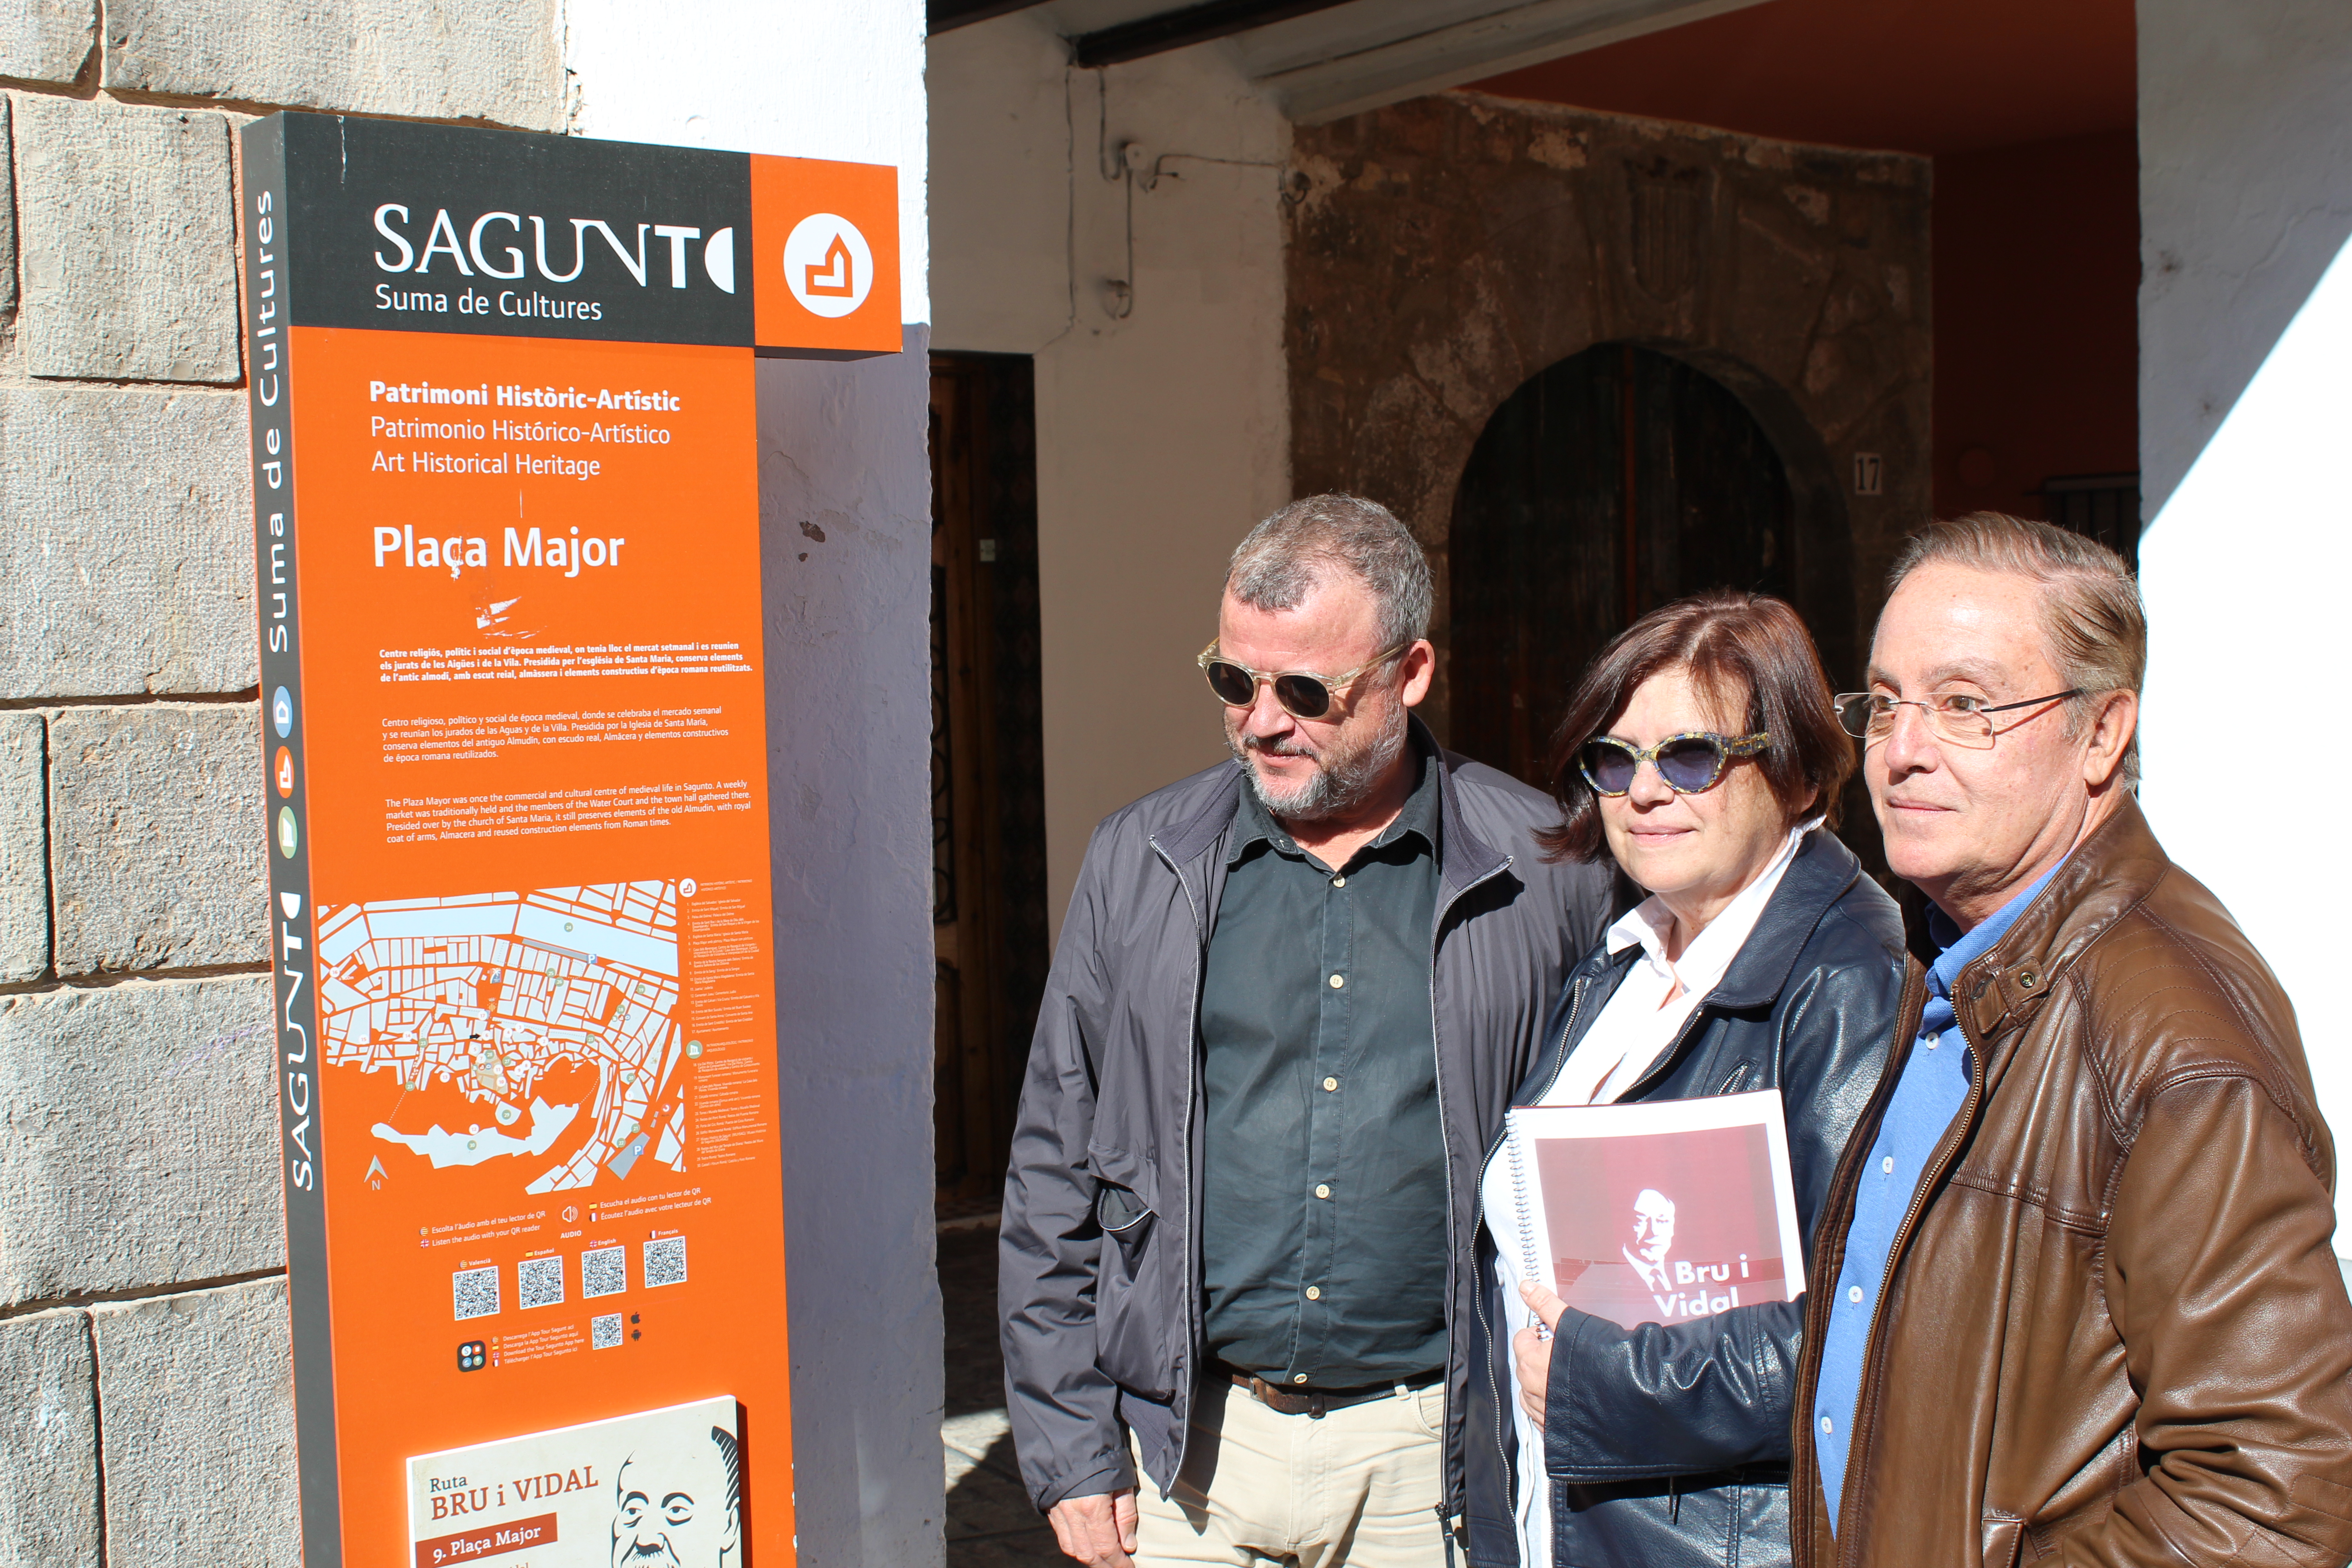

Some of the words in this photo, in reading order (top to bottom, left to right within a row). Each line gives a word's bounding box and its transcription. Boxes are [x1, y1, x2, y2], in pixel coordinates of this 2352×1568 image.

[257, 191, 279, 406] Cultures
[376, 285, 448, 313] Suma
[459, 289, 490, 315] de
[499, 291, 602, 320] Cultures
[370, 381, 488, 406] Patrimoni
[496, 384, 681, 412] Històric-Artístic
[372, 416, 485, 440] Patrimonio
[493, 419, 671, 444] Histórico-Artístico
[263, 428, 282, 490] de
[372, 451, 406, 472] Art
[413, 451, 508, 474] Historical
[516, 453, 601, 481] Heritage
[1857, 458, 1880, 490] 17
[504, 526, 625, 578] Major
[270, 513, 288, 652] Suma
[379, 649, 408, 658] Centre
[409, 648, 443, 659] religiós,
[445, 647, 472, 658] polític
[473, 647, 476, 656] i
[478, 646, 502, 656] social
[503, 646, 534, 657] d'època
[536, 645, 573, 655] medieval,
[587, 644, 608, 653] tenia
[608, 644, 623, 652] lloc
[624, 643, 632, 652] el
[633, 644, 660, 652] mercat
[661, 642, 695, 651] setmanal
[696, 642, 700, 650] i
[710, 641, 739, 650] reunien
[380, 661, 393, 670] els
[393, 661, 420, 672] jurats
[421, 660, 432, 669] de
[433, 660, 446, 669] les
[447, 659, 475, 670] Aigües
[477, 659, 480, 667] i
[482, 658, 493, 667] de
[494, 658, 502, 667] la
[503, 658, 522, 666] Vila.
[524, 657, 561, 666] Presidida
[562, 658, 576, 667] per
[577, 655, 613, 666] l'església
[614, 655, 625, 664] de
[626, 655, 648, 664] Santa
[650, 654, 674, 664] Maria,
[710, 652, 744, 662] elements
[380, 673, 392, 682] de
[393, 672, 420, 681] l'antic
[421, 671, 452, 681] almodí,
[453, 671, 471, 680] amb
[472, 671, 495, 679] escut
[496, 669, 517, 680] reial,
[519, 669, 559, 678] almàssera
[559, 668, 563, 677] i
[564, 668, 600, 677] elements
[601, 666, 649, 676] constructius
[650, 666, 680, 676] d'època
[710, 663, 753, 672] reutilitzats.
[385, 799, 401, 808] The
[403, 798, 424, 807] Plaza
[426, 797, 451, 807] Mayor
[490, 793, 504, 802] the
[505, 790, 547, 801] commercial
[549, 789, 563, 799] and
[564, 788, 593, 798] cultural
[594, 788, 617, 796] centre
[618, 785, 627, 794] of
[628, 784, 661, 794] medieval
[662, 783, 674, 792] life
[683, 783, 715, 793] Sagunto.
[716, 781, 722, 789] A
[723, 779, 748, 789] weekly
[372, 1179, 381, 1191] N
[600, 1199, 624, 1208] Escucha
[631, 1196, 647, 1204] audio
[691, 1187, 701, 1196] QR
[702, 1197, 711, 1205] QR
[431, 1225, 454, 1234] Escolta
[476, 1219, 490, 1227] amb
[535, 1210, 546, 1219] QR
[463, 1233, 481, 1242] audio
[481, 1230, 495, 1239] with
[495, 1230, 510, 1238] your
[510, 1226, 521, 1235] QR
[521, 1224, 541, 1232] reader
[560, 1230, 582, 1239] AUDIO
[598, 1238, 617, 1246] English
[1675, 1261, 1730, 1284] Bru
[1740, 1254, 1749, 1278] i
[1653, 1286, 1739, 1317] Vidal
[430, 1476, 468, 1493] Ruta
[431, 1486, 489, 1520] BRU
[497, 1484, 506, 1506] i
[512, 1465, 598, 1501] VIDAL
[433, 1548, 447, 1564] 9.
[451, 1538, 492, 1556] Plaça
[495, 1527, 542, 1547] Major
